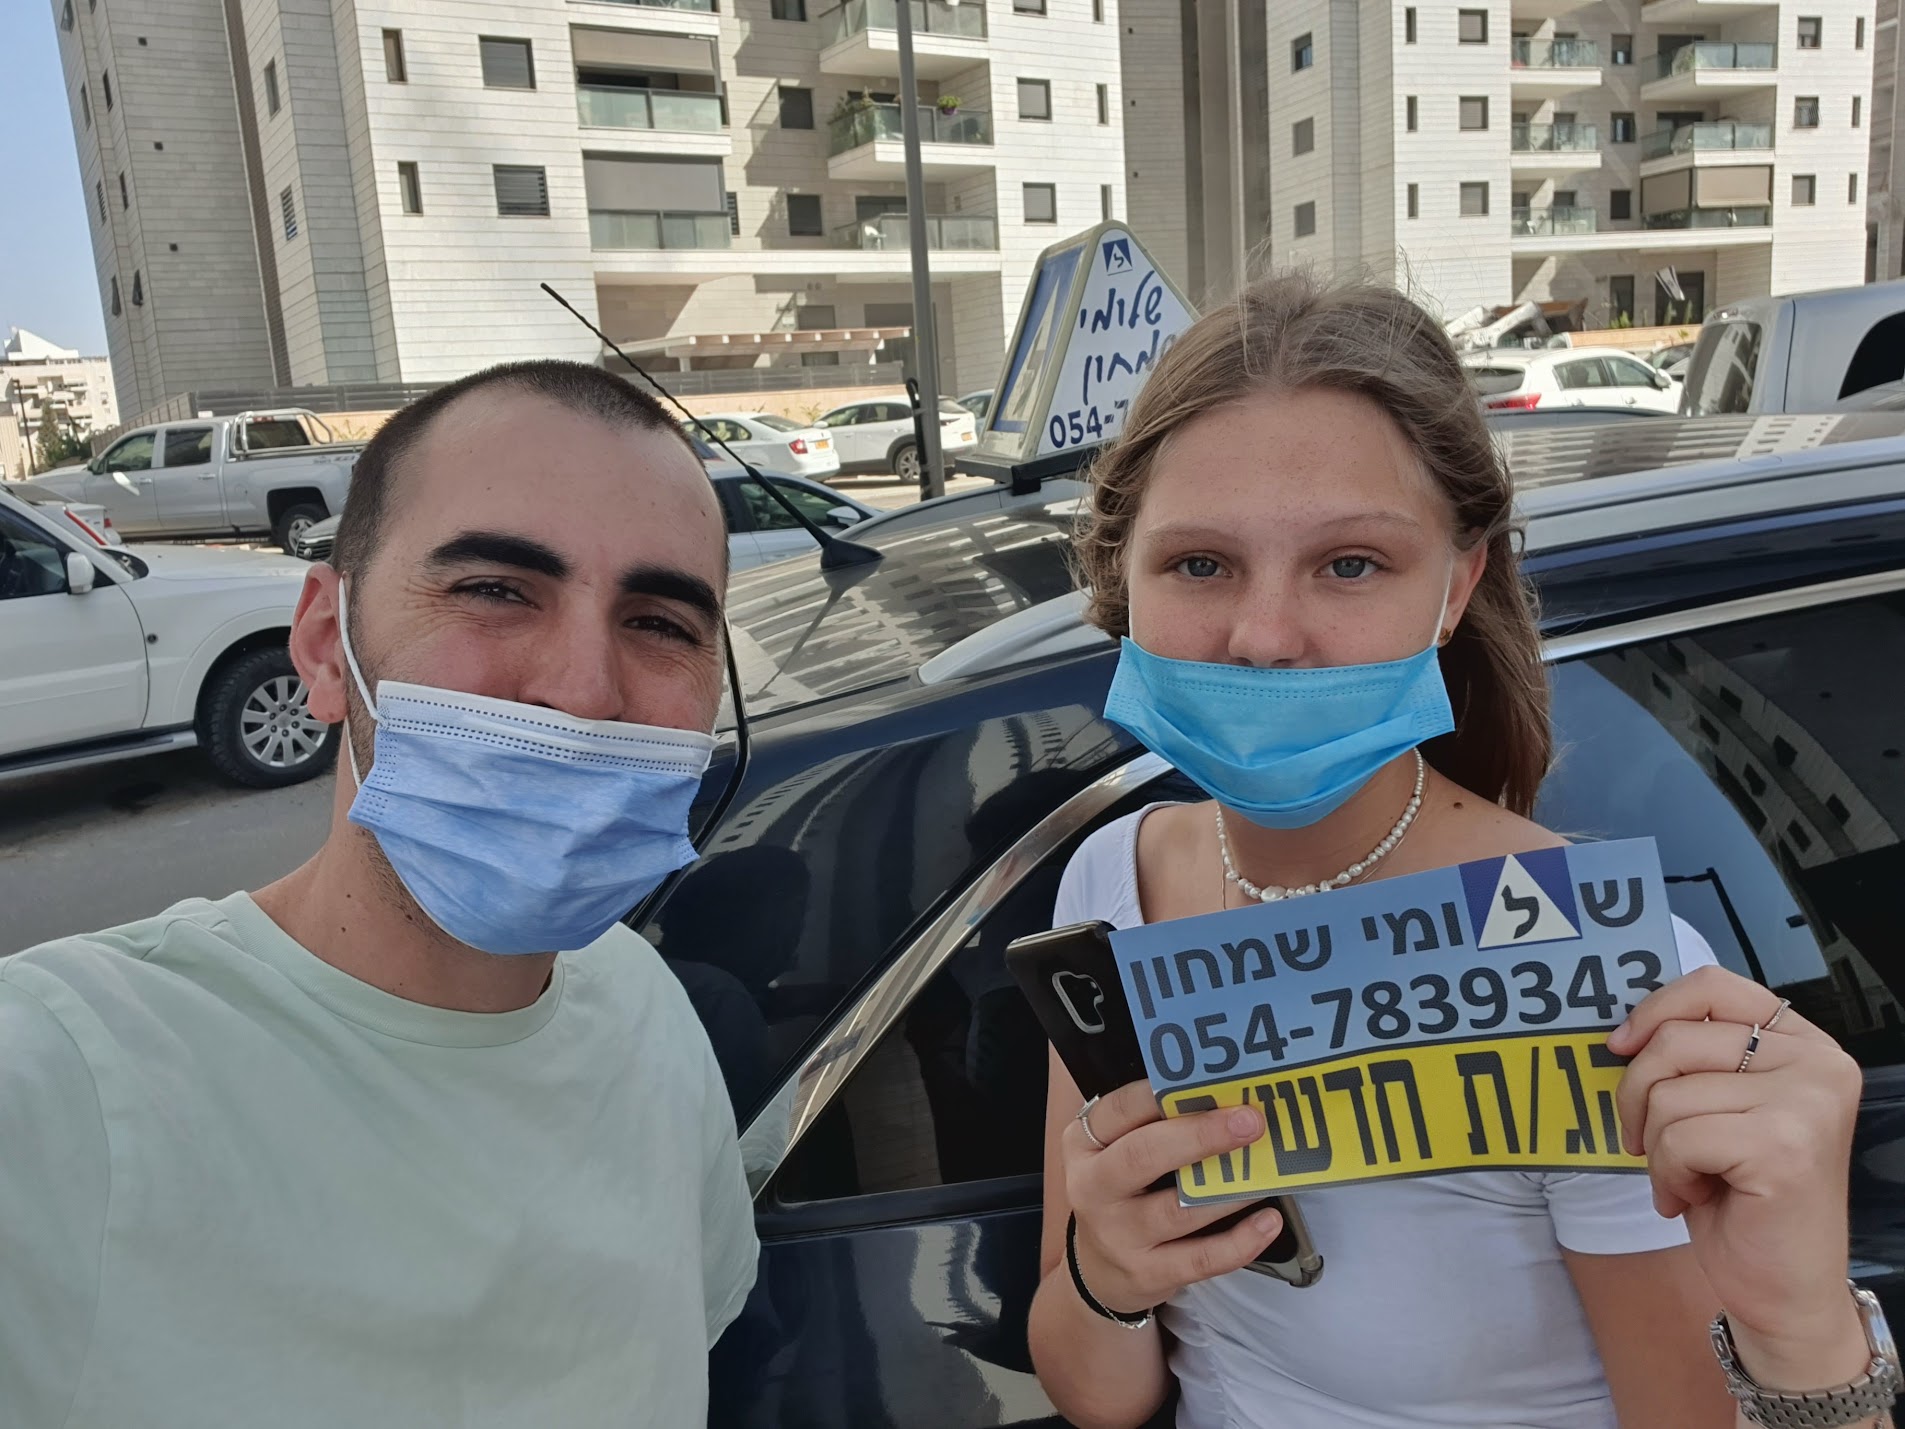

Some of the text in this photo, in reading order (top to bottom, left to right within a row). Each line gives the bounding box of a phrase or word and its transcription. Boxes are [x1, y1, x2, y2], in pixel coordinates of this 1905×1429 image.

[1079, 269, 1163, 334] שלומי
[1050, 399, 1129, 448] 054-7
[1129, 924, 1332, 1019] שמחון
[1149, 949, 1665, 1082] 054-7839343
[1455, 1044, 1635, 1155] הג/ת
